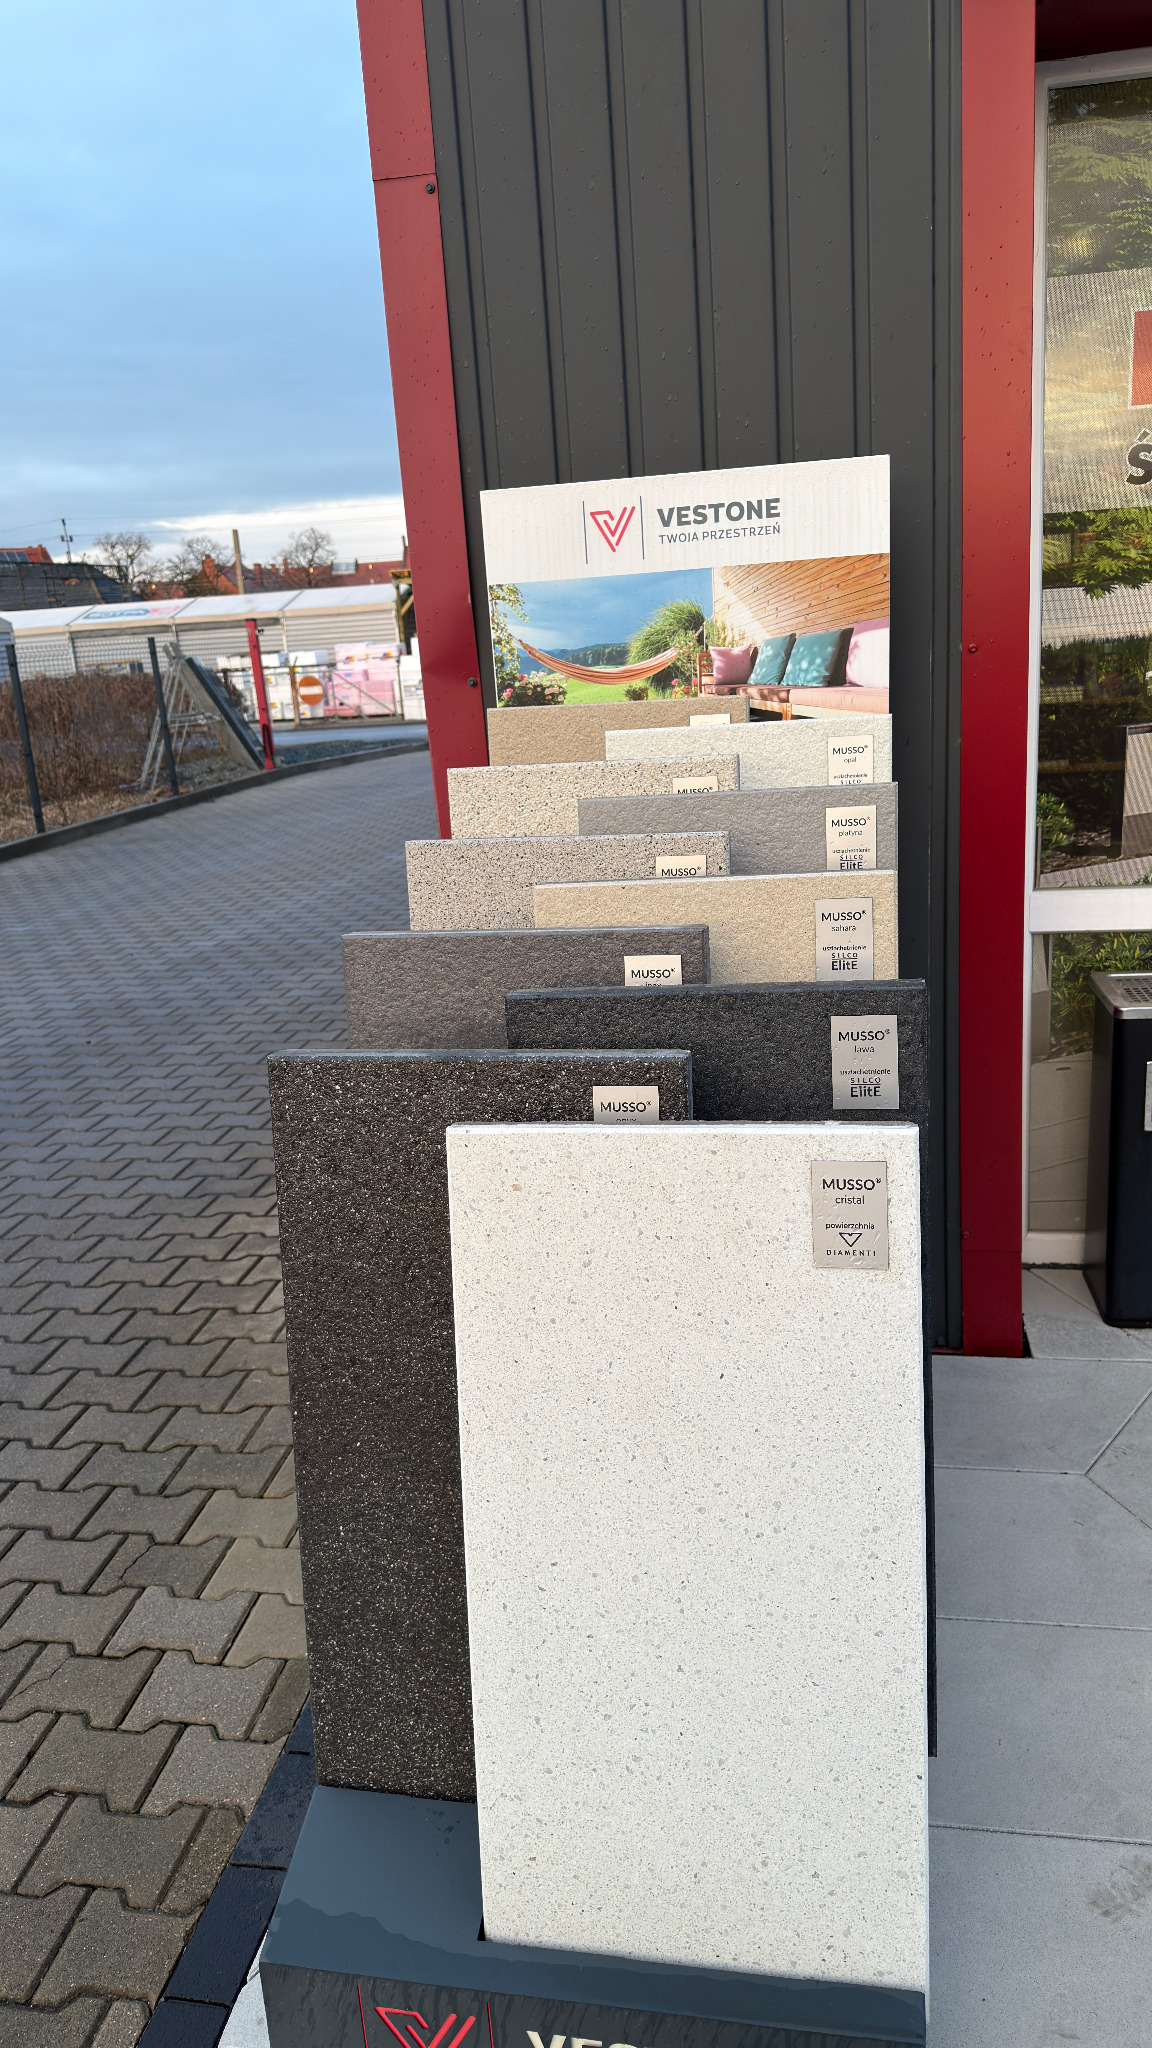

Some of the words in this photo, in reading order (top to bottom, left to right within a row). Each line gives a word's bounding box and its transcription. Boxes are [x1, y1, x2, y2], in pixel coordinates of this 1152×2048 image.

[656, 497, 780, 528] VESTONE
[658, 532, 699, 544] TWOJA
[702, 522, 780, 541] PRZESTRZEŃ
[831, 924, 857, 932] sahara
[831, 960, 858, 971] ElitE
[854, 1045, 875, 1053] lawa
[850, 1086, 882, 1098] ElitE
[835, 1195, 865, 1205] cristal
[825, 1222, 875, 1231] powierzchnia
[826, 1249, 876, 1257] DIAMENTI
